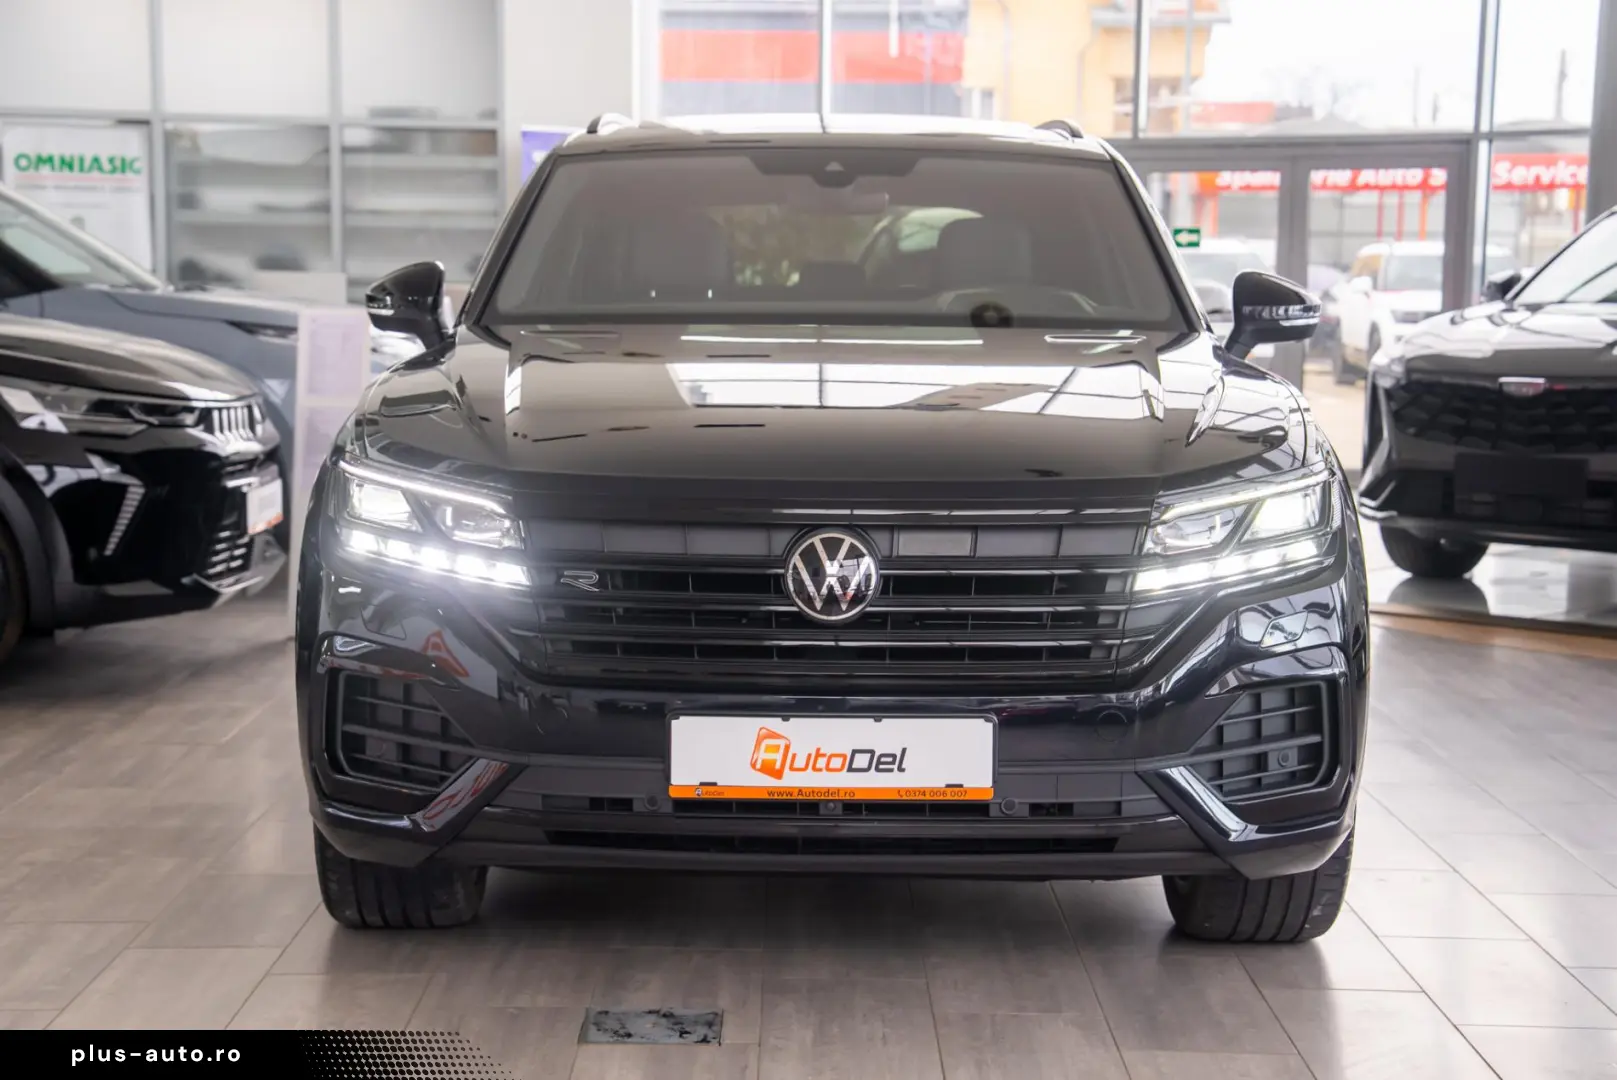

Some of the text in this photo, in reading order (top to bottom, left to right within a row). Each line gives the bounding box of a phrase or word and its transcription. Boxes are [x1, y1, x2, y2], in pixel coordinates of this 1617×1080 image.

[751, 729, 908, 779] AutoDel
[767, 788, 856, 798] www.Autodel.ro
[905, 790, 927, 798] 0374
